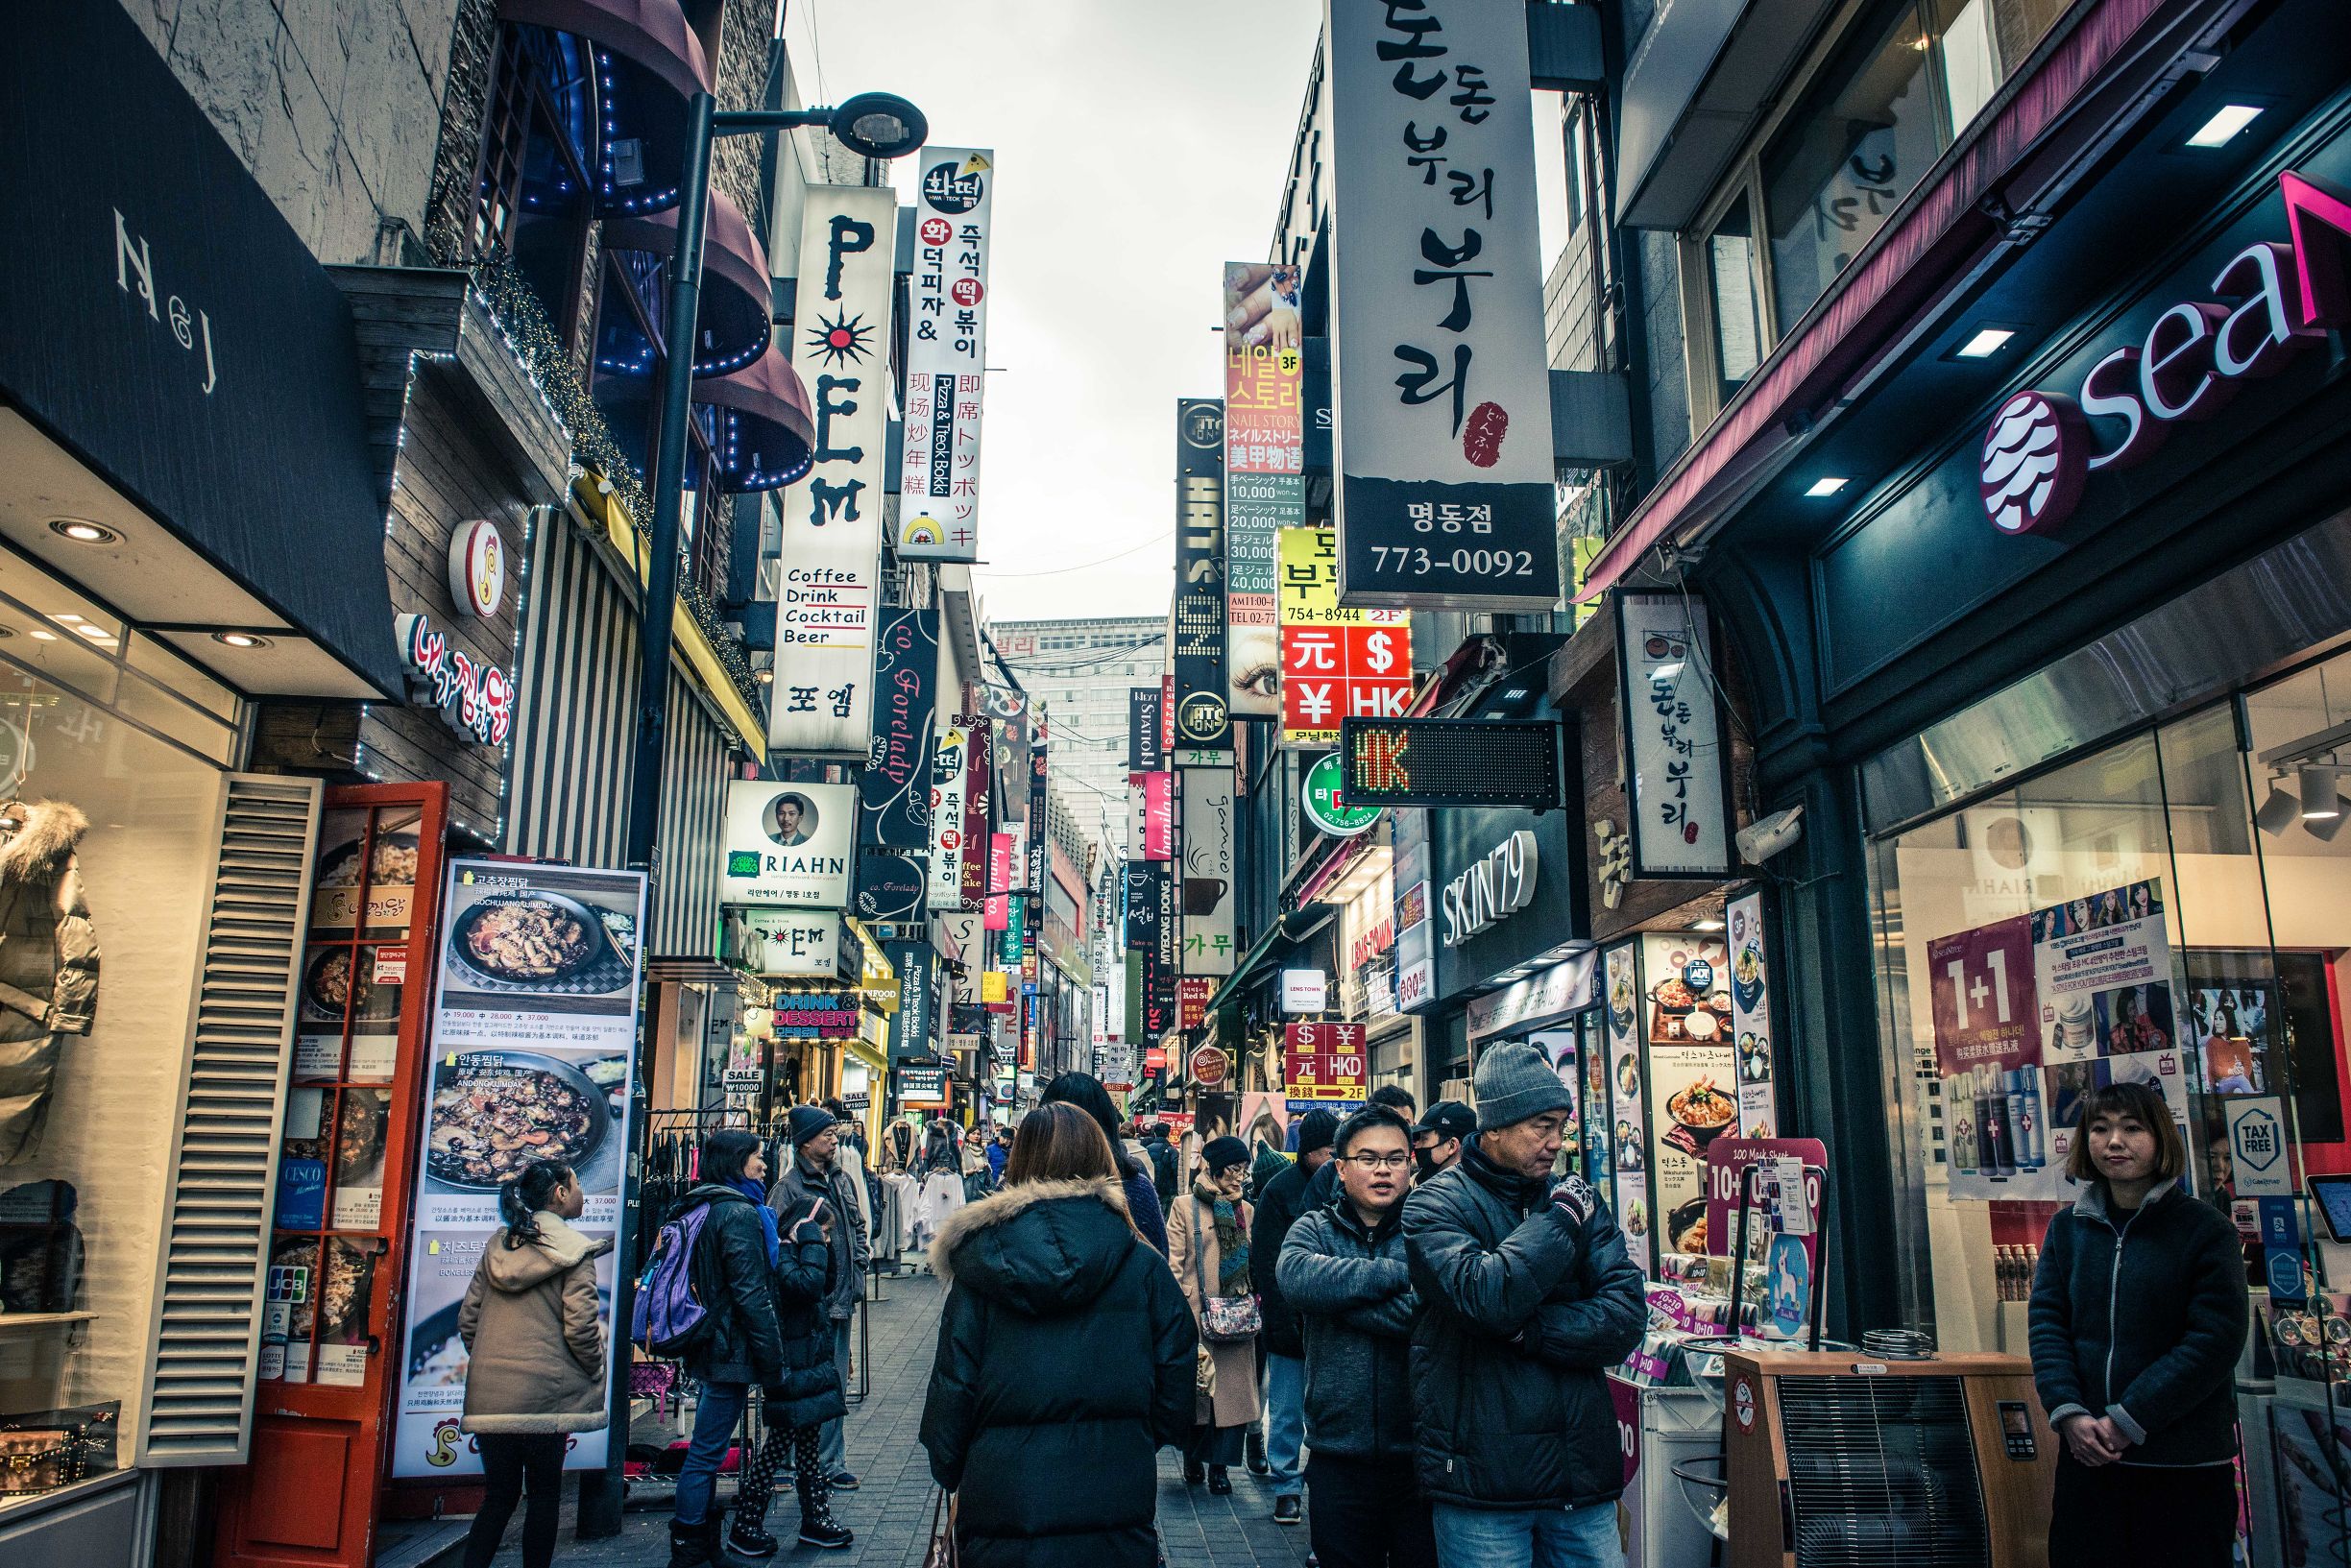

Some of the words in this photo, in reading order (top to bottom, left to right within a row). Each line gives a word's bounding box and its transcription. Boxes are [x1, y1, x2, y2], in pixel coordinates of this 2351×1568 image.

[1229, 345, 1276, 379] 네일
[1283, 356, 1297, 370] 3F
[937, 376, 953, 409] Pizza
[1229, 380, 1300, 414] 스토리
[1230, 414, 1259, 426] NAIL
[1231, 486, 1275, 499] 10,000
[1231, 517, 1275, 528] 20,000
[1408, 502, 1492, 534] 명동점
[1371, 545, 1534, 577] 773-0092
[788, 568, 857, 584] Coffee
[787, 589, 837, 603] Drink
[786, 610, 865, 624] Cocktail
[1230, 612, 1248, 623] TEL
[1288, 608, 1360, 621] 754-8944
[1370, 610, 1402, 622] 2F
[785, 630, 829, 644] Beer
[1292, 633, 1335, 669] 元
[1367, 630, 1393, 674] $
[1297, 683, 1332, 724] ¥
[1141, 704, 1155, 766] STATION
[765, 856, 844, 875] RIAHN
[962, 862, 982, 871] ffee
[786, 890, 800, 899] 명동
[1160, 880, 1171, 914] DONG
[1160, 914, 1171, 965] MYEONG
[1184, 933, 1233, 958] 가무
[1691, 967, 1710, 980] ADT
[1947, 949, 2011, 1030] 1+1
[775, 994, 839, 1011] DRINK
[841, 995, 858, 1011] &
[772, 1011, 858, 1026] DESSERT
[459, 1054, 504, 1067] 안동찜닭
[1296, 1055, 1317, 1076] 元
[1329, 1056, 1362, 1076] HKD
[728, 1071, 760, 1080] SALE
[1348, 1088, 1364, 1098] 2F
[2242, 1124, 2270, 1139] TAX
[2244, 1139, 2271, 1153] FREE
[1733, 1148, 1747, 1161] 100
[284, 1167, 321, 1182] CESCO
[268, 1278, 303, 1291] JCB
[1658, 1291, 1682, 1310] 10+10
